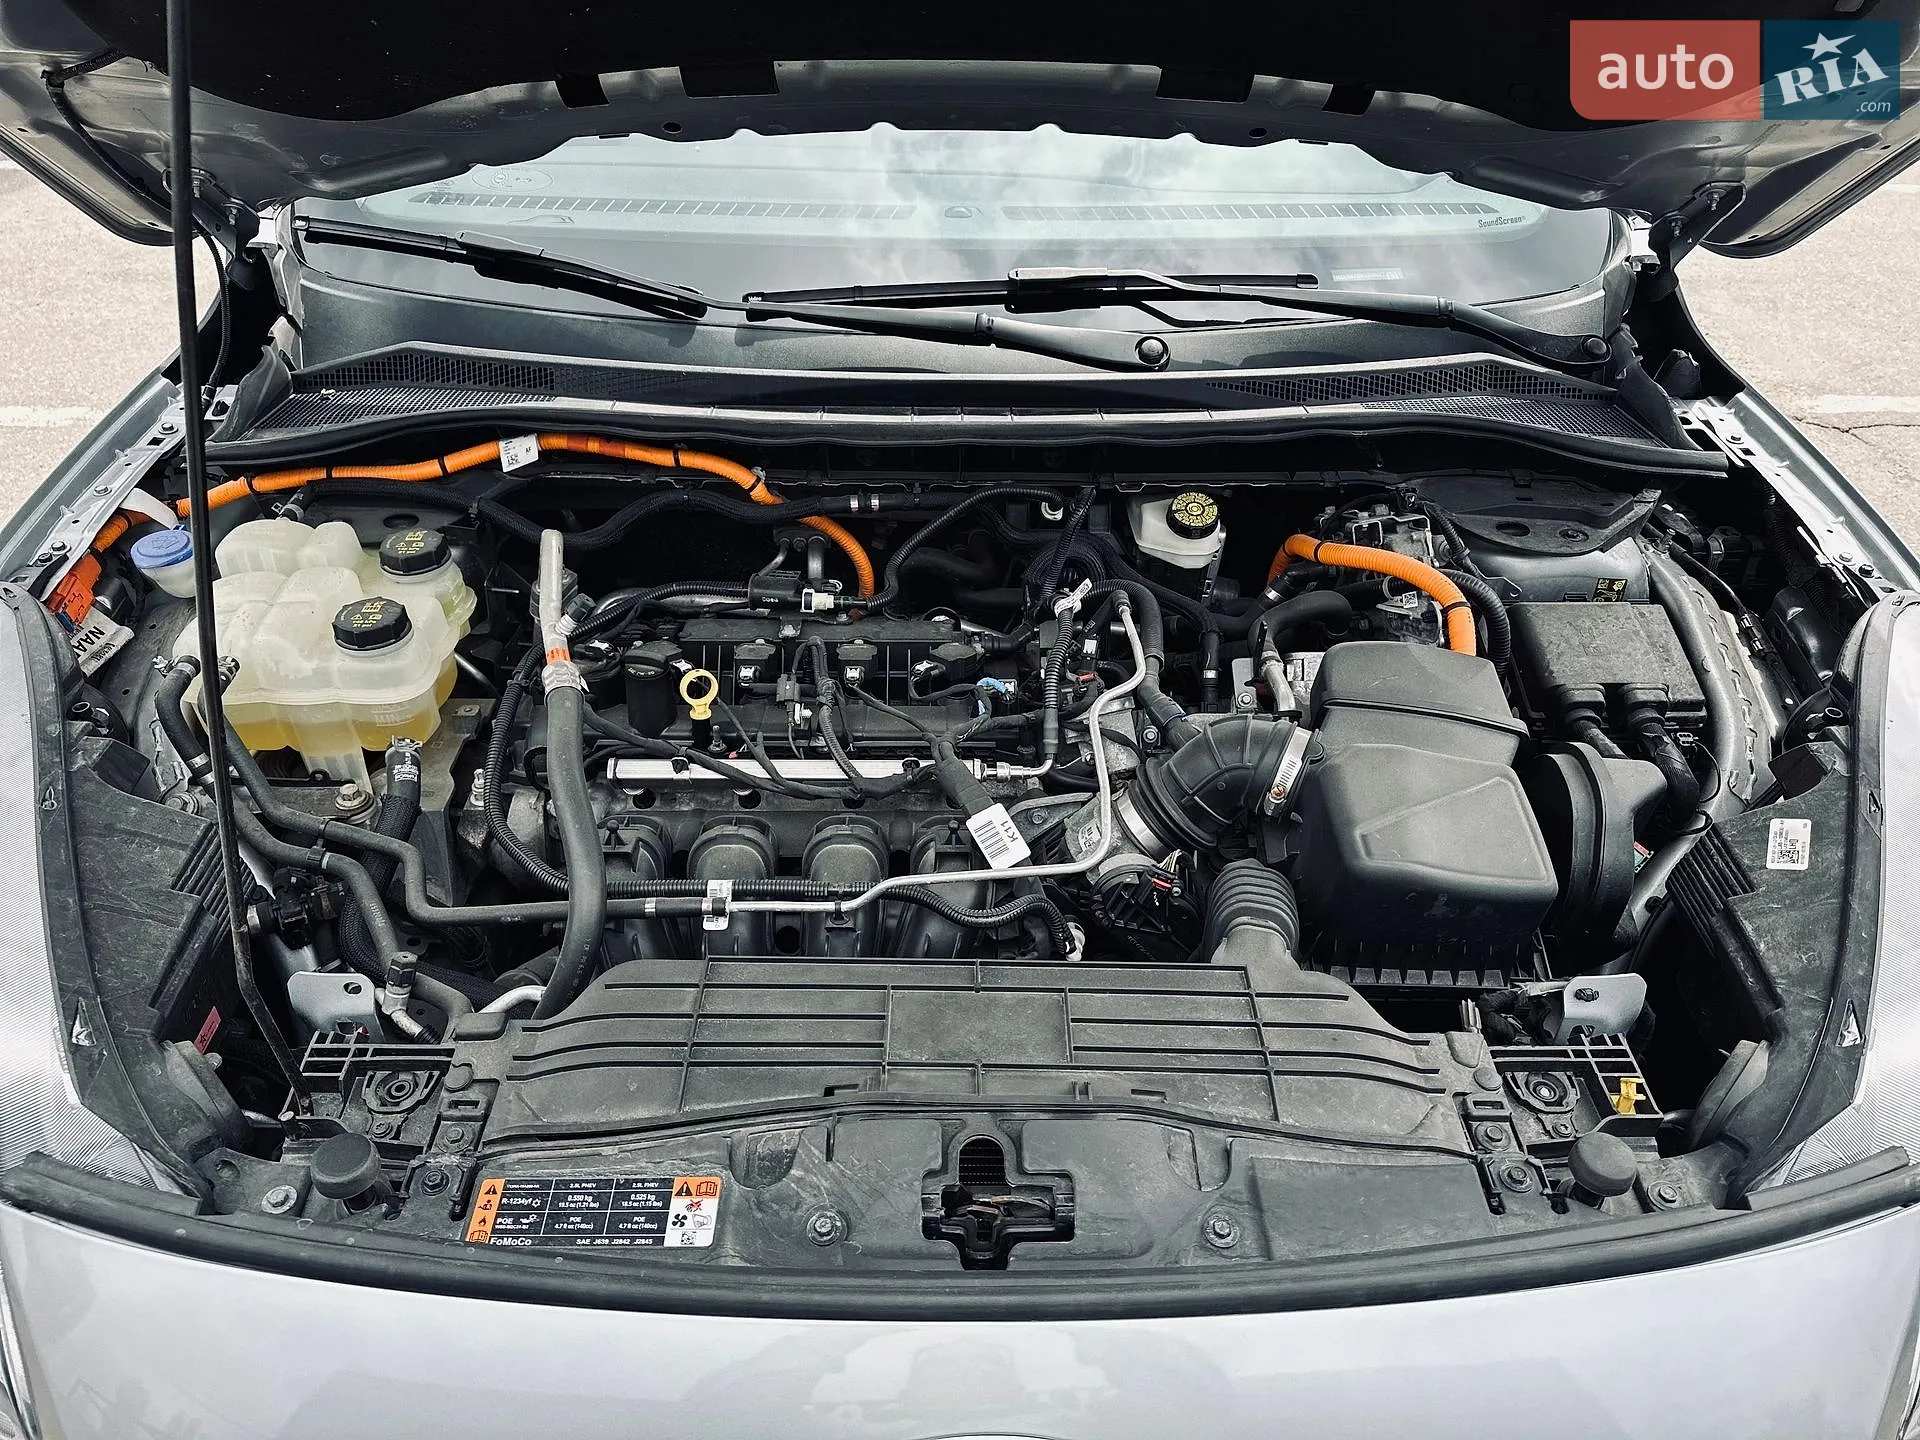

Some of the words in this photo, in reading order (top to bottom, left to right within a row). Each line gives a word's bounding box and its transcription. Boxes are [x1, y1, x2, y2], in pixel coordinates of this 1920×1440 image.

[1000, 820, 1019, 843] K11
[501, 1197, 532, 1206] R-1234yf
[496, 1217, 514, 1225] POE
[489, 1237, 532, 1246] FoMoCo
